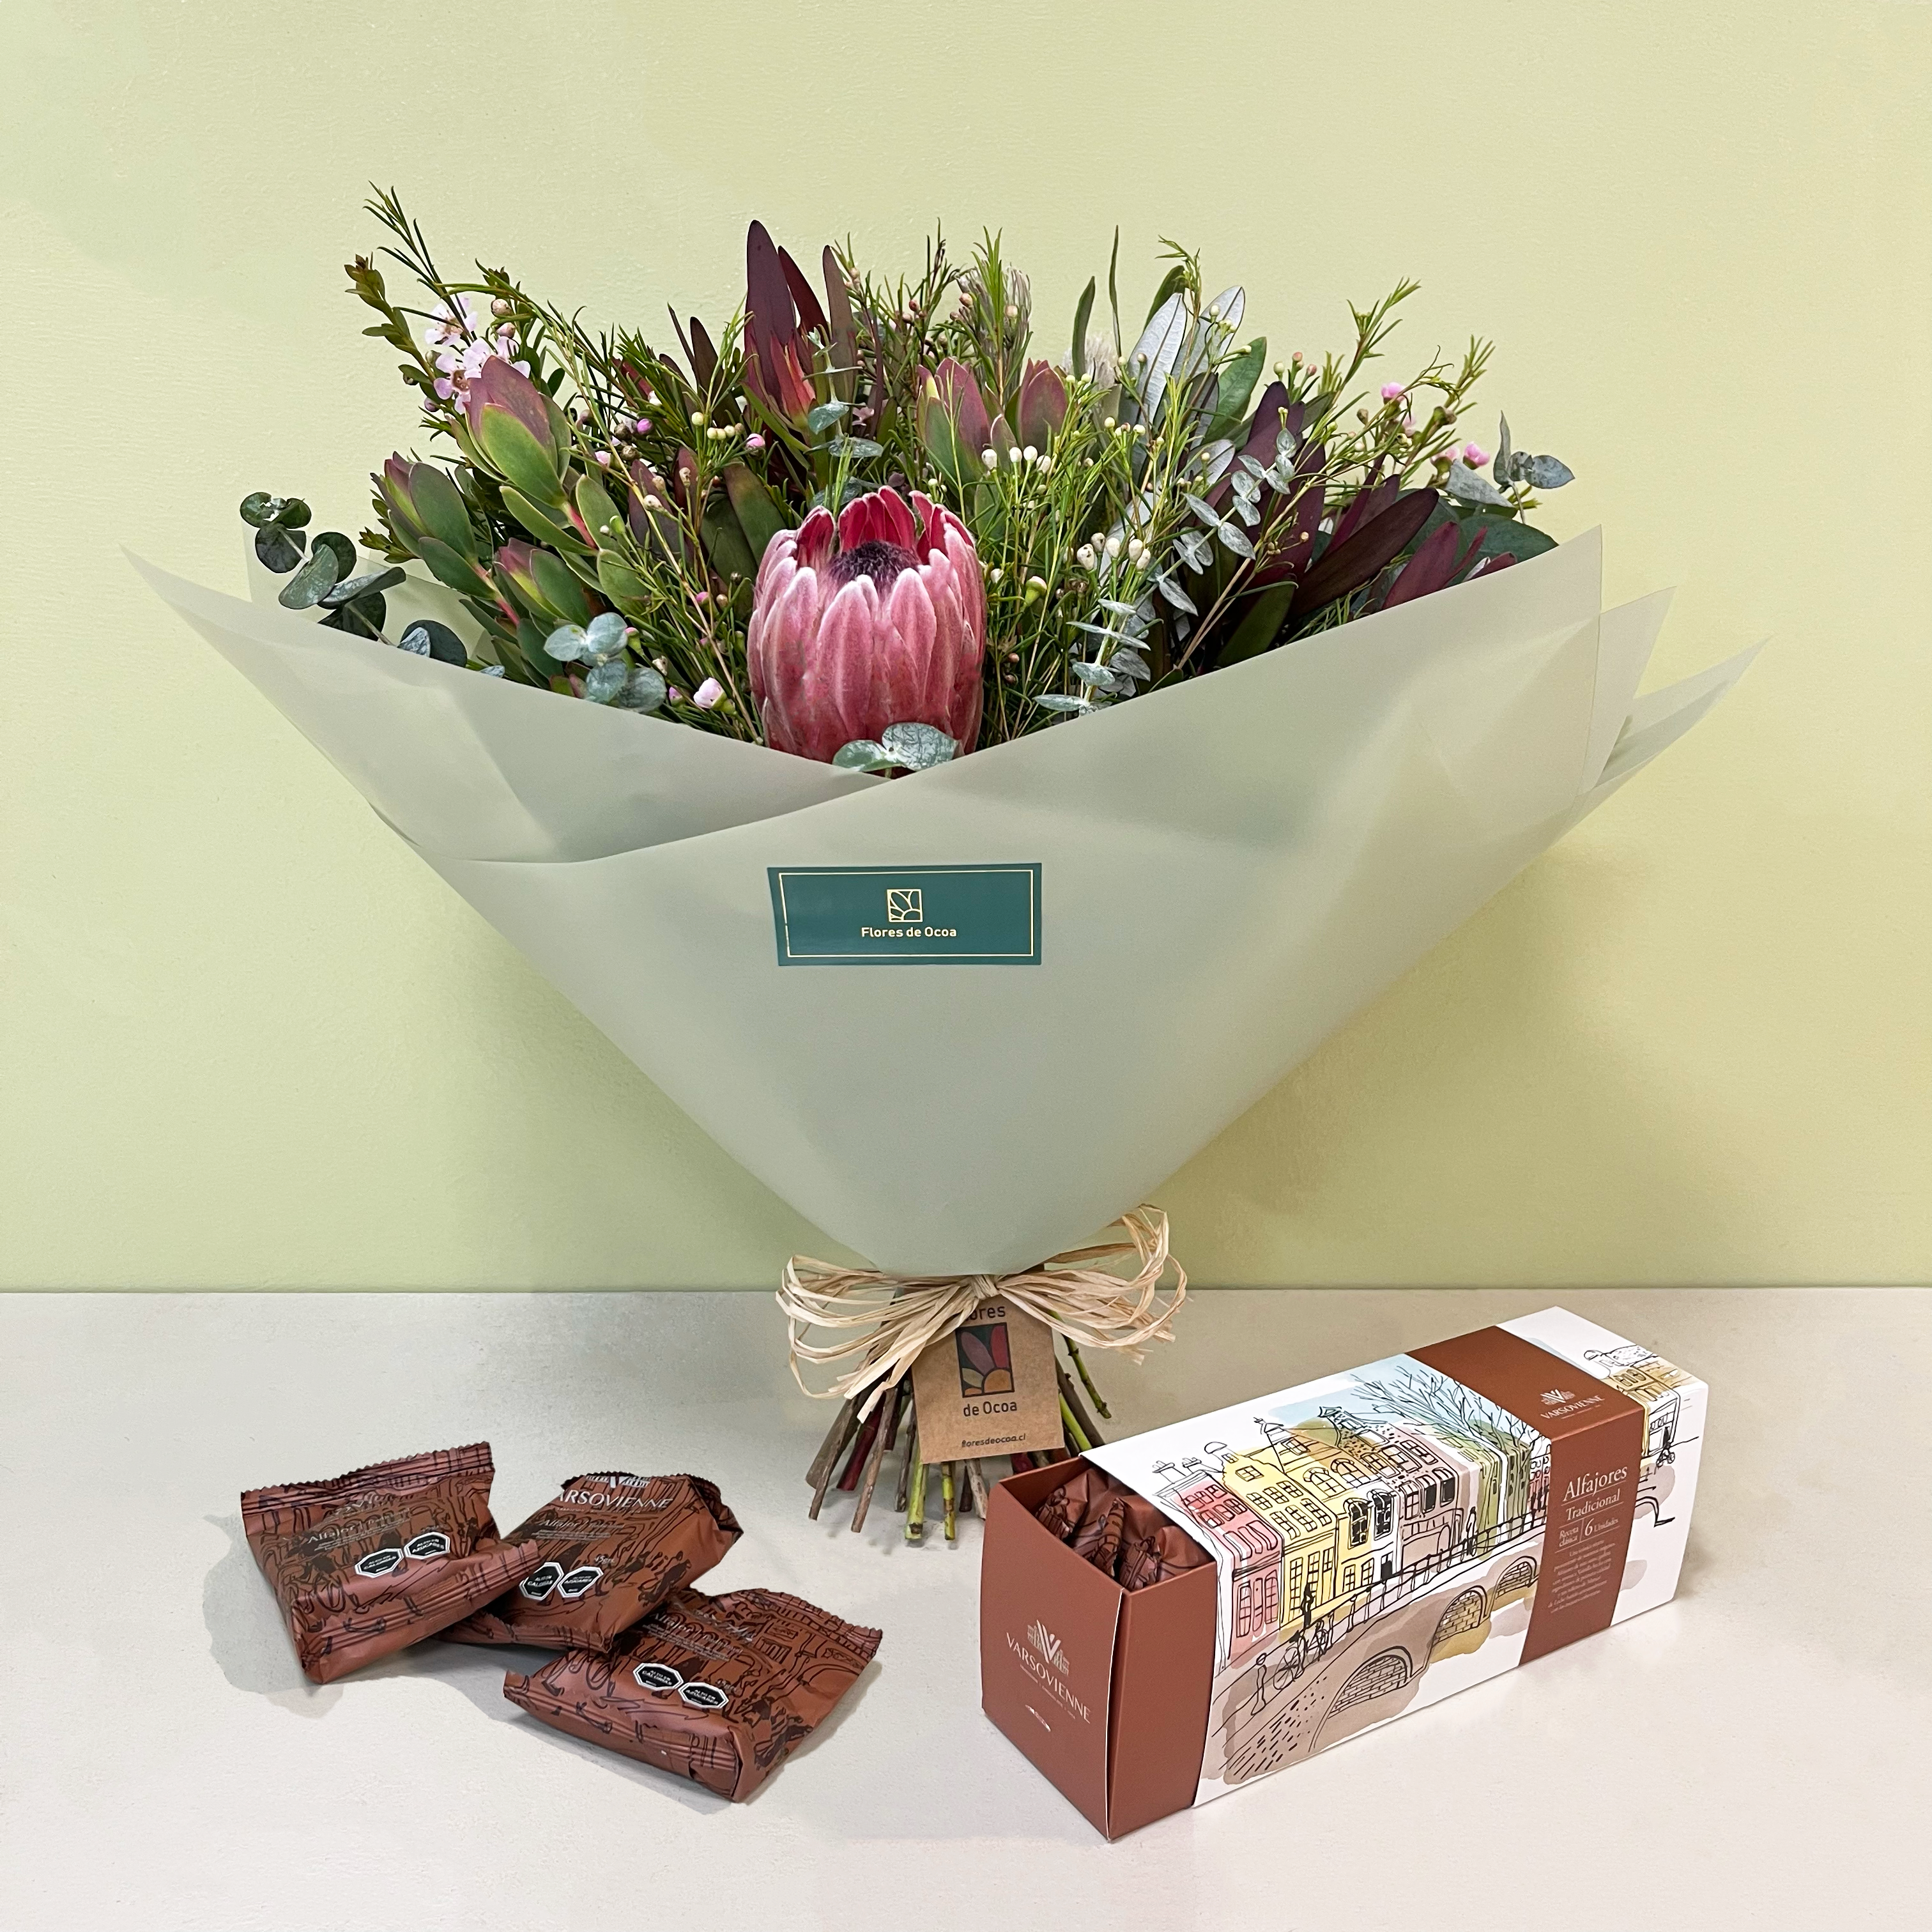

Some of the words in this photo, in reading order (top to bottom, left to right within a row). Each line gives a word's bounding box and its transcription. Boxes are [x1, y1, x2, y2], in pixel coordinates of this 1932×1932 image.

[861, 927, 903, 937] Flores
[906, 927, 922, 937] de
[924, 926, 957, 937] Ocoa
[965, 1306, 1006, 1322] ores
[963, 1403, 980, 1417] de
[983, 1400, 1018, 1415] Ocoa
[1540, 1395, 1606, 1420] VARSOVIENNE
[961, 1433, 1026, 1448] floresdeocoa.cl
[1563, 1466, 1628, 1501] Alfajores
[1566, 1488, 1621, 1521] Tradicional
[1584, 1517, 1595, 1537] 6
[1006, 1632, 1091, 1724] VARSOVIENNE
